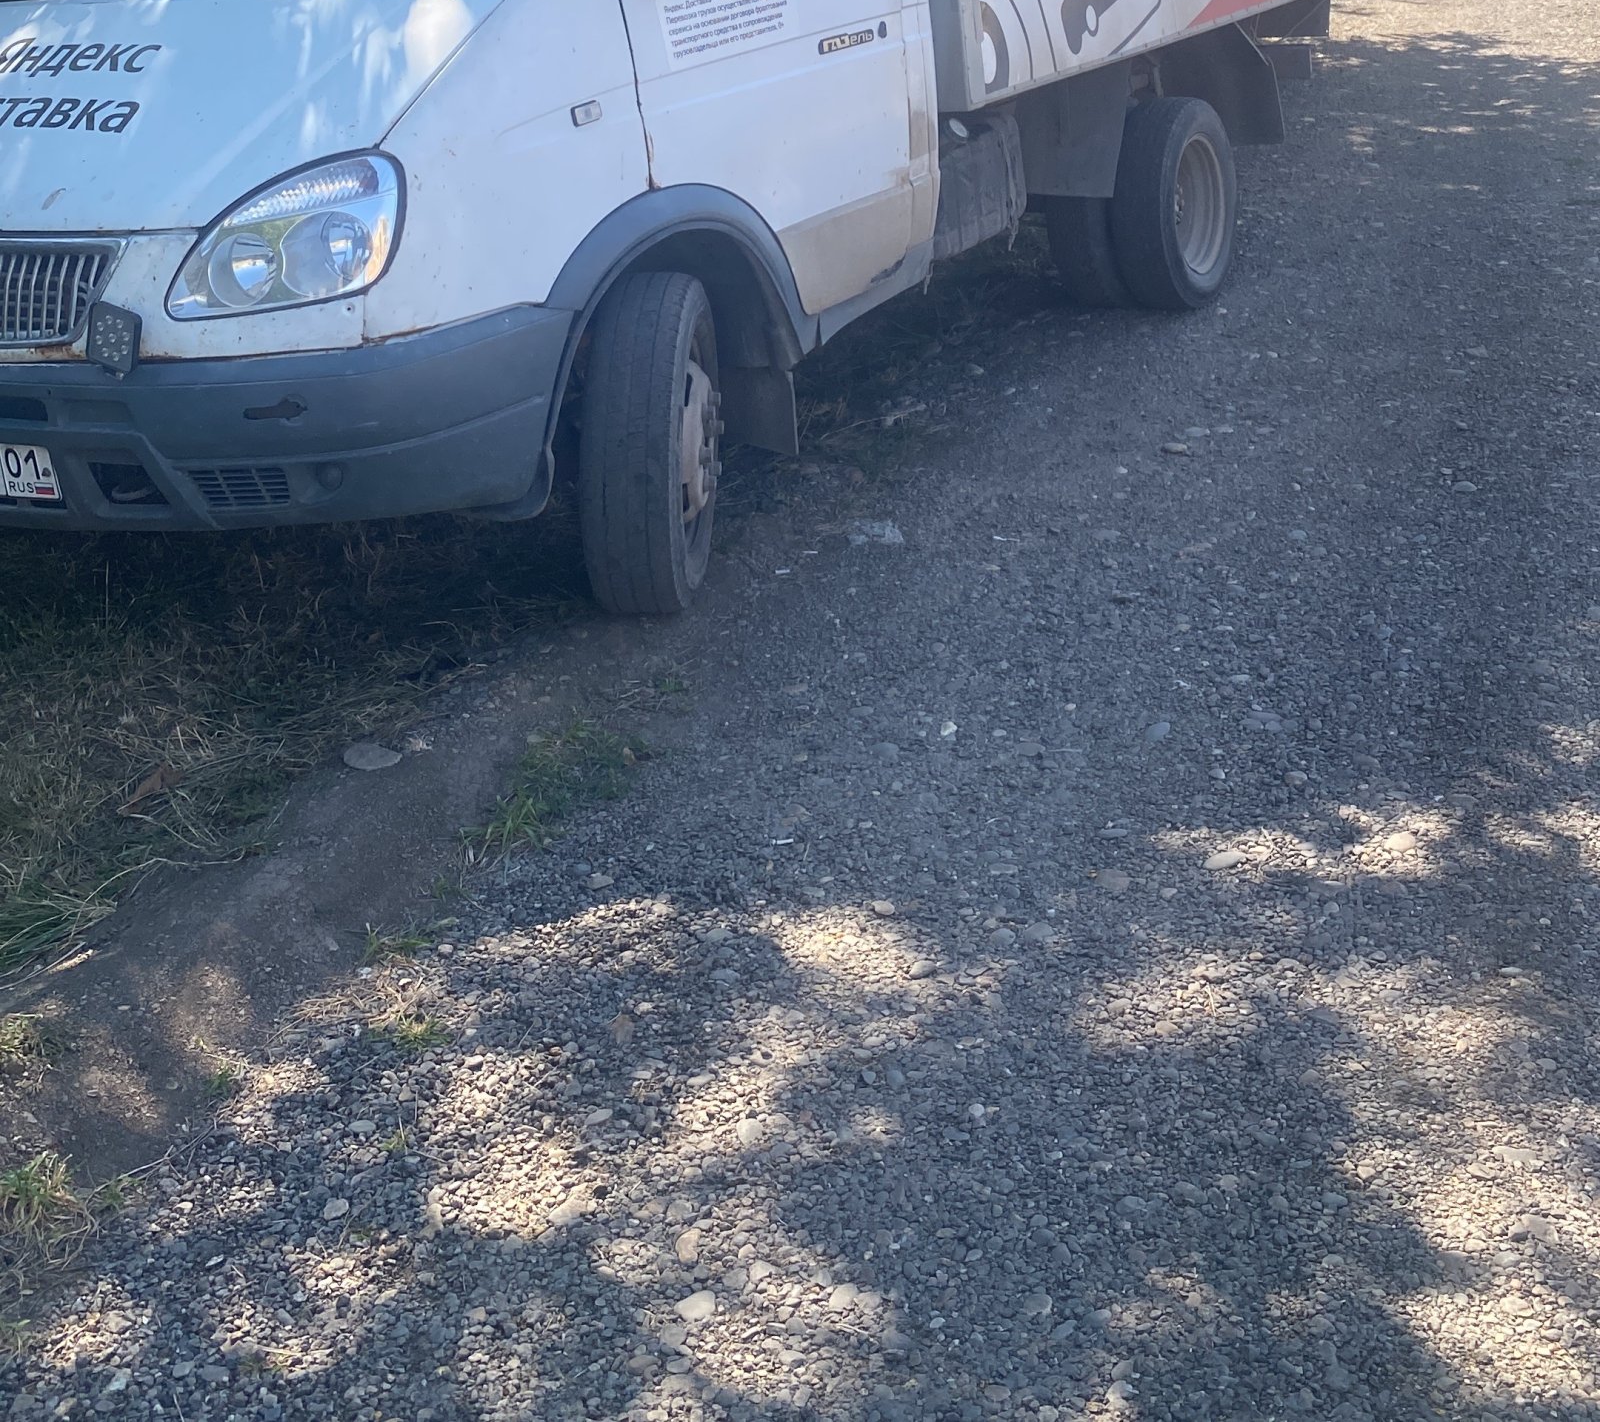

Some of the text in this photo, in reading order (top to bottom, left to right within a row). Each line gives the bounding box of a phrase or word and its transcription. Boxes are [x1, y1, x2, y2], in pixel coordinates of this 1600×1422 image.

[664, 4, 685, 13] Яндекс
[666, 12, 697, 25] Перевозка
[698, 7, 716, 17] грузов
[668, 25, 692, 36] сервиса
[700, 15, 730, 27] основании
[730, 8, 755, 21] договора
[671, 30, 713, 47] транспортного
[714, 24, 738, 36] средства
[0, 37, 162, 77] Яндекс
[673, 41, 718, 59] грузовладельца
[719, 38, 730, 46] или
[0, 97, 140, 134] тавка
[5, 448, 41, 480] 01
[8, 481, 35, 493] RUS
